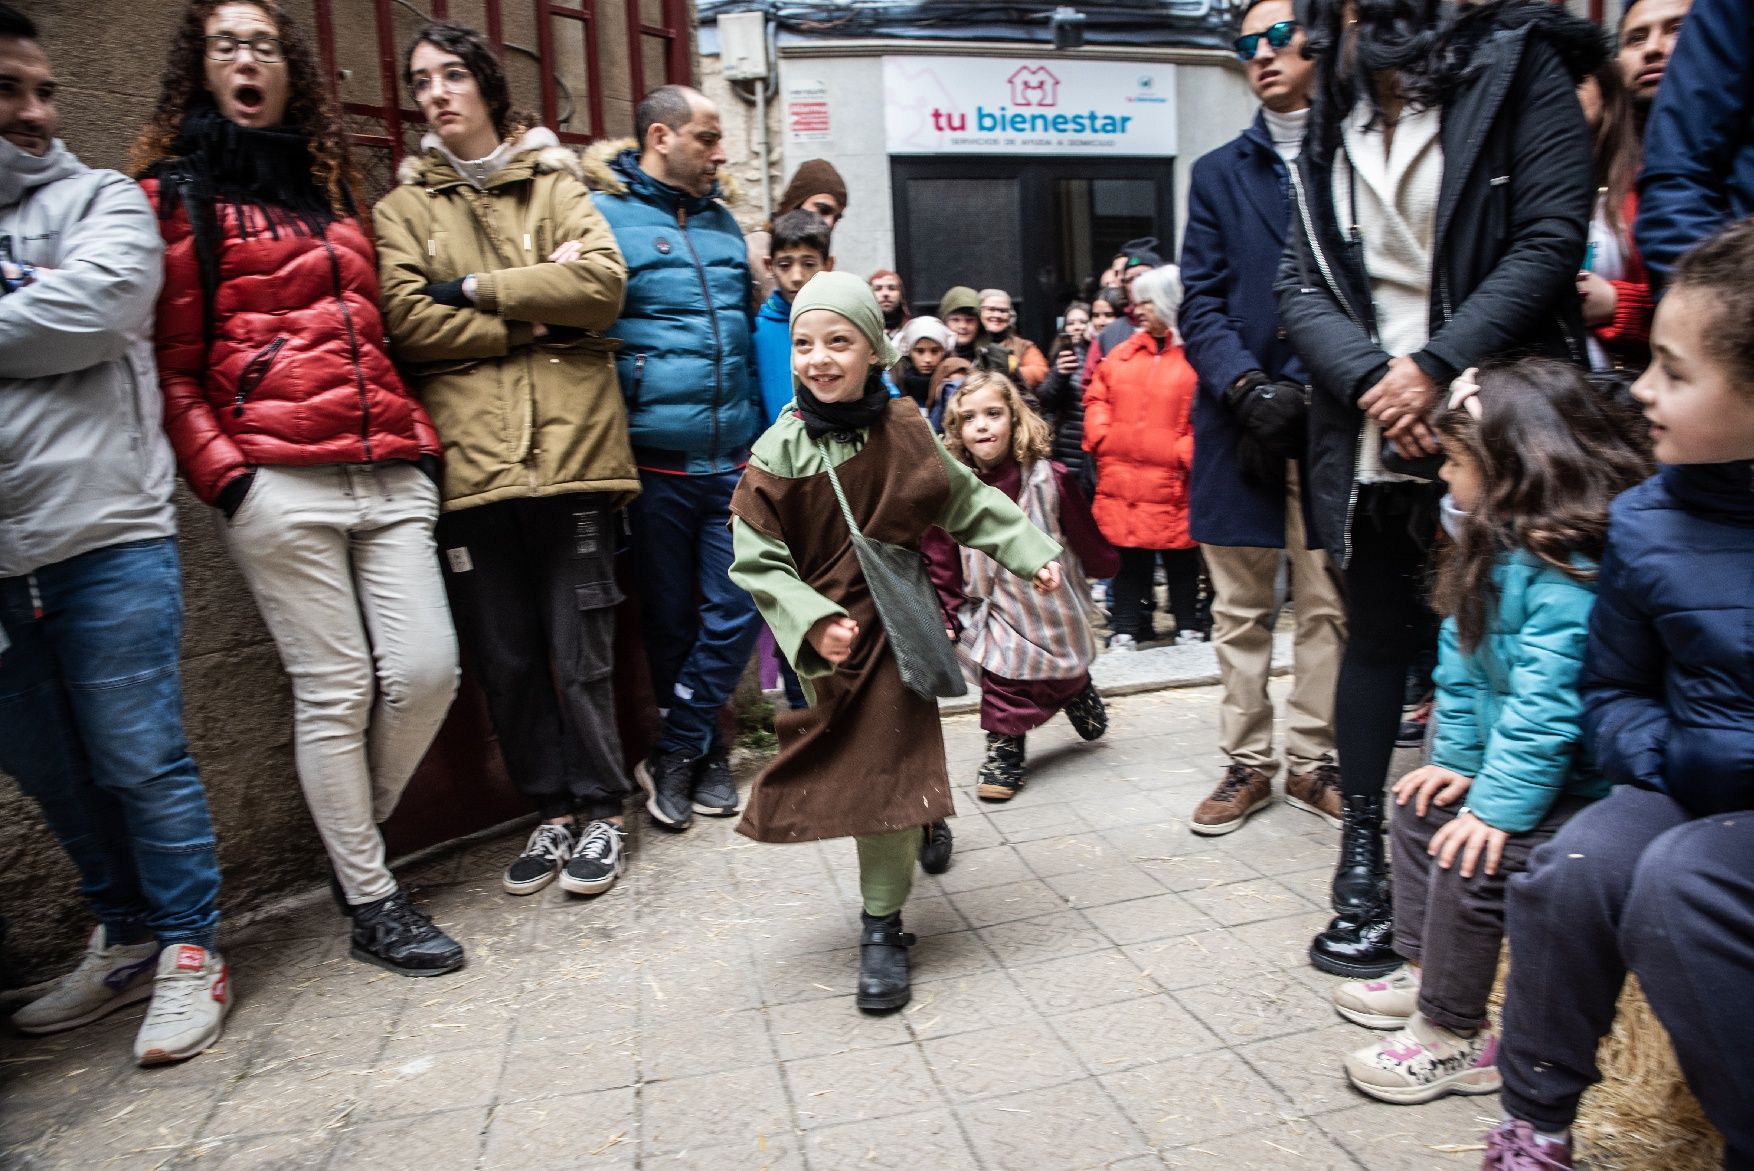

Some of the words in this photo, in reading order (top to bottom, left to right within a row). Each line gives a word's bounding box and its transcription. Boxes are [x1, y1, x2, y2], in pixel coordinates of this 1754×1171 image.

[931, 108, 966, 132] tu
[976, 105, 1132, 135] bienestar
[951, 138, 1000, 146] SERVICIOS
